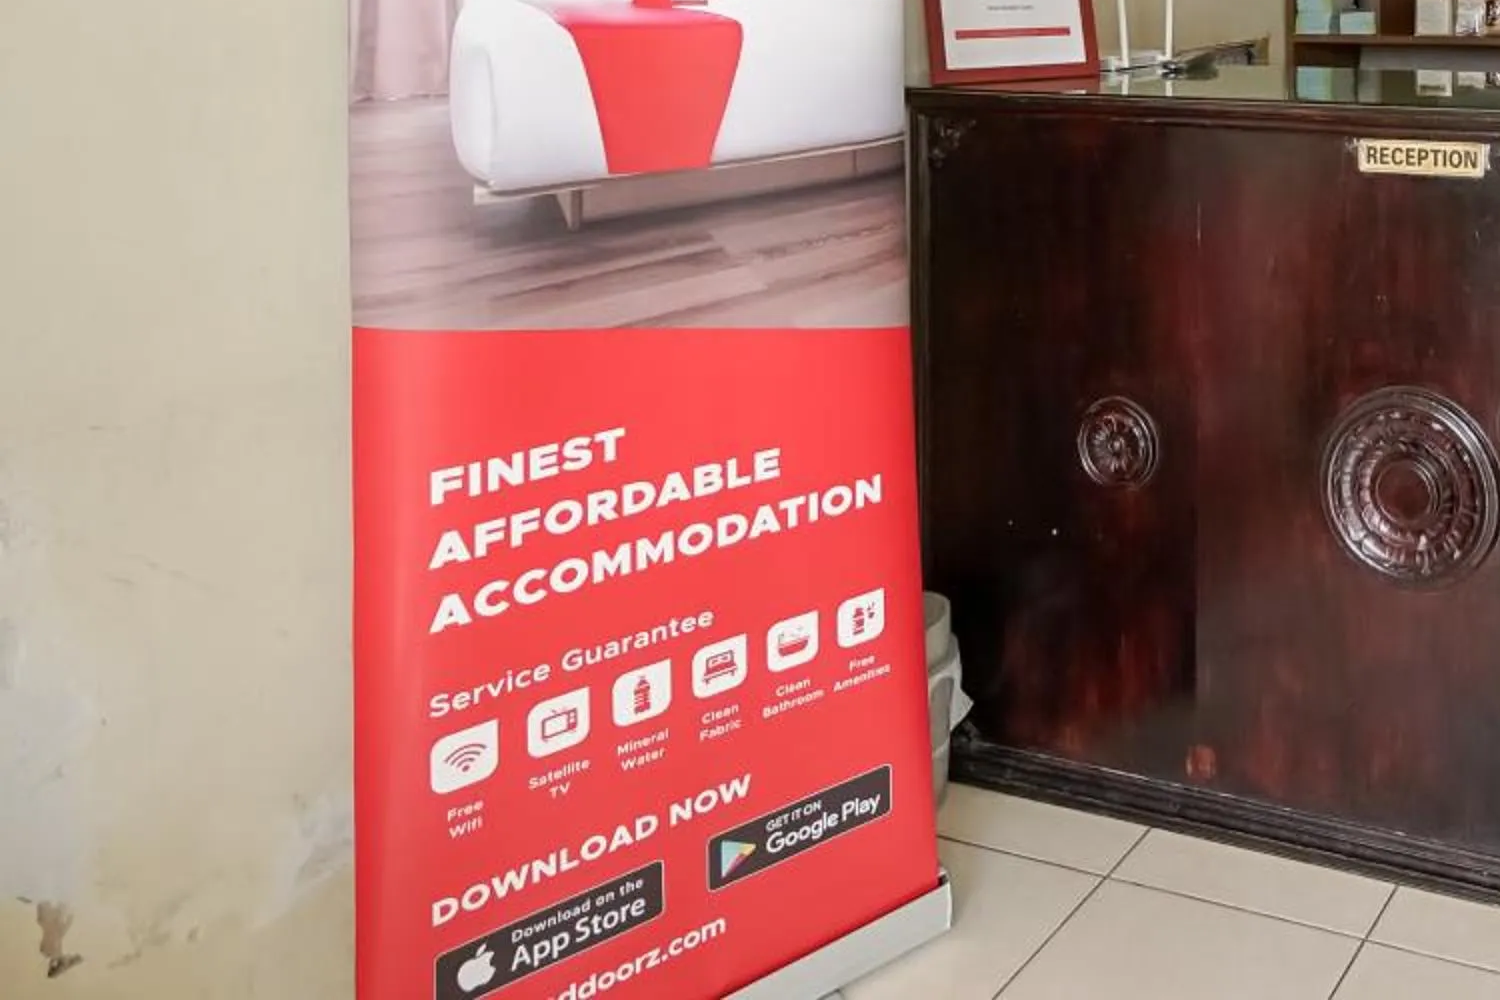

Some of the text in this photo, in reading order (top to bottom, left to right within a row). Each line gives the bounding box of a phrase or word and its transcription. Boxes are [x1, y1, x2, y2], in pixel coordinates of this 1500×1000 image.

[1366, 146, 1478, 169] RECEPTION
[430, 427, 625, 505] FINEST
[428, 447, 782, 570] AFFORDABLE
[428, 474, 883, 634] ACCOMMODATION
[429, 610, 715, 718] Service Guarantee
[849, 655, 875, 671] Free
[762, 688, 825, 719] Bathroom
[775, 678, 811, 697] Clean
[701, 703, 740, 725] Clean
[616, 727, 670, 756] Mineral
[699, 719, 743, 742] Fabric
[528, 759, 591, 791] Satellite
[621, 747, 667, 772] Water
[549, 782, 571, 799] TV
[447, 800, 484, 822] Free
[765, 800, 822, 832] GET IT ON
[766, 794, 881, 854] Google Play
[432, 773, 752, 927] DOWNLOAD NOW
[511, 878, 644, 945] Download on the
[511, 897, 647, 973] App Store
[548, 917, 727, 1000] ddoorz.com
